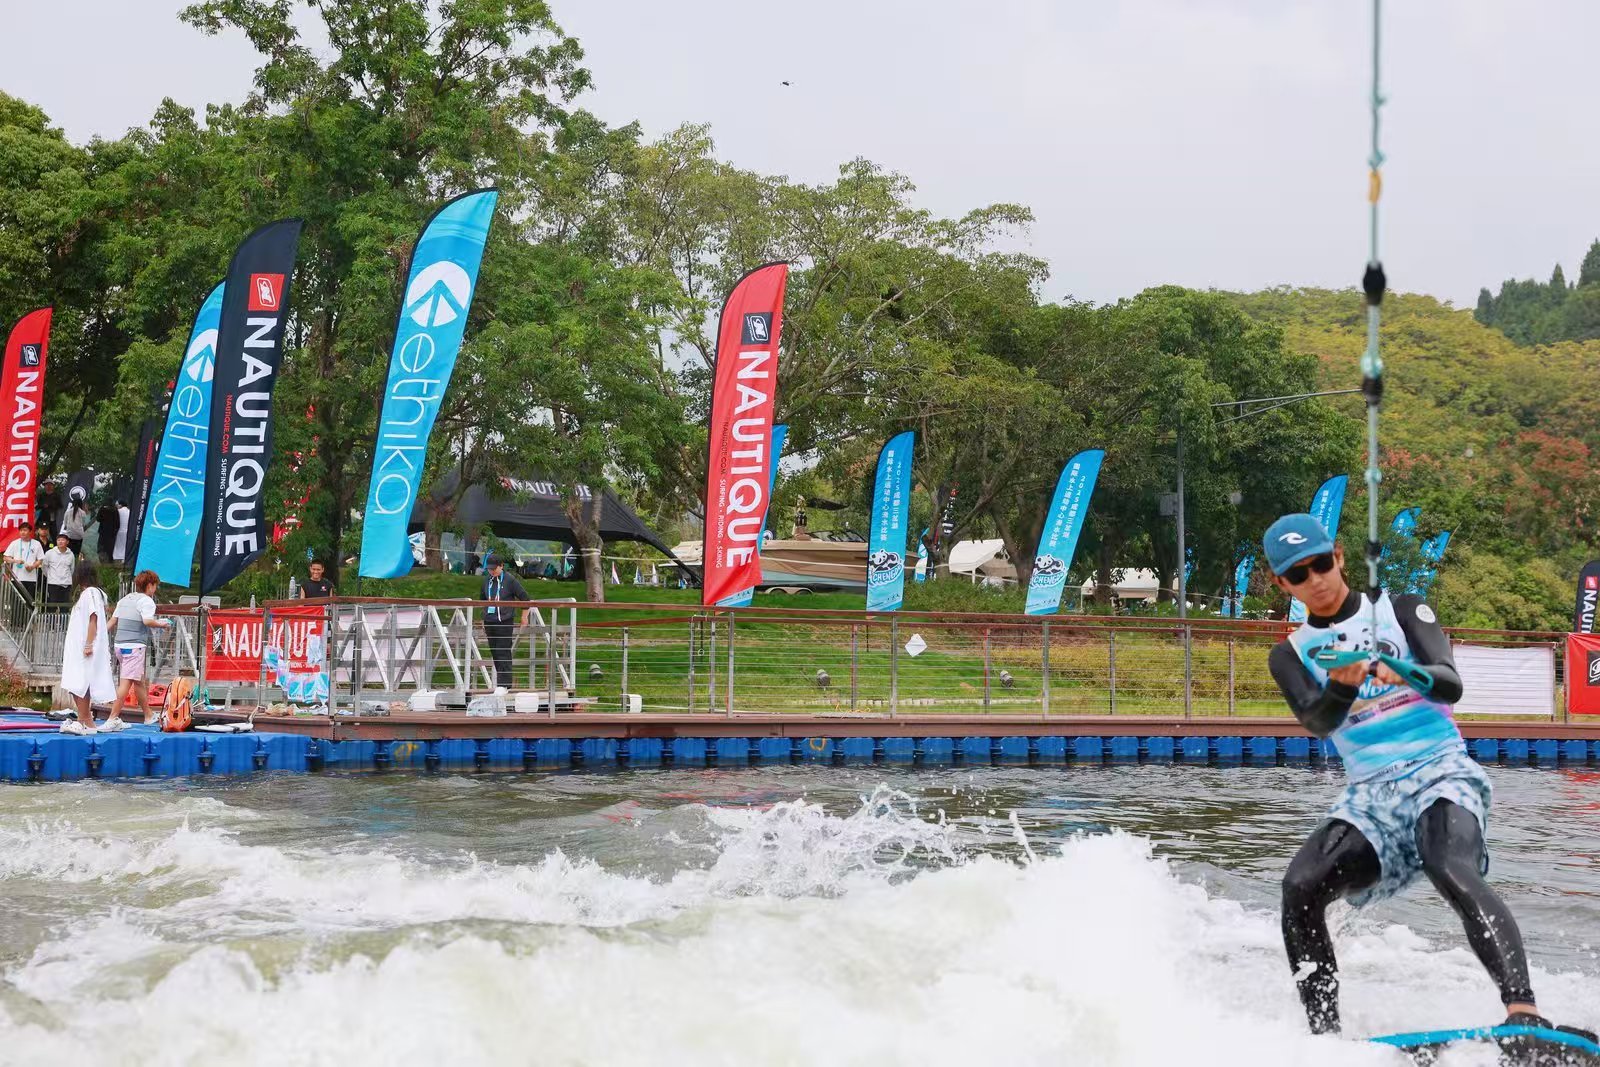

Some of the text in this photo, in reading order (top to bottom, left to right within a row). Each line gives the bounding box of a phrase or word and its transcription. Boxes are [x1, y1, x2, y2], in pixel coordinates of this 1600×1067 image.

[3, 371, 40, 529] NAUTIQUE
[151, 385, 209, 530] ethika
[213, 394, 233, 557] NAUTIQUE.COM SURFING RIDING SKIING
[225, 317, 278, 556] NAUTIQUE
[373, 332, 441, 515] ethika
[718, 478, 727, 508] SURFING
[726, 350, 771, 568] NAUTIQUE
[715, 545, 723, 568] SKIING
[716, 515, 725, 538] RIDING
